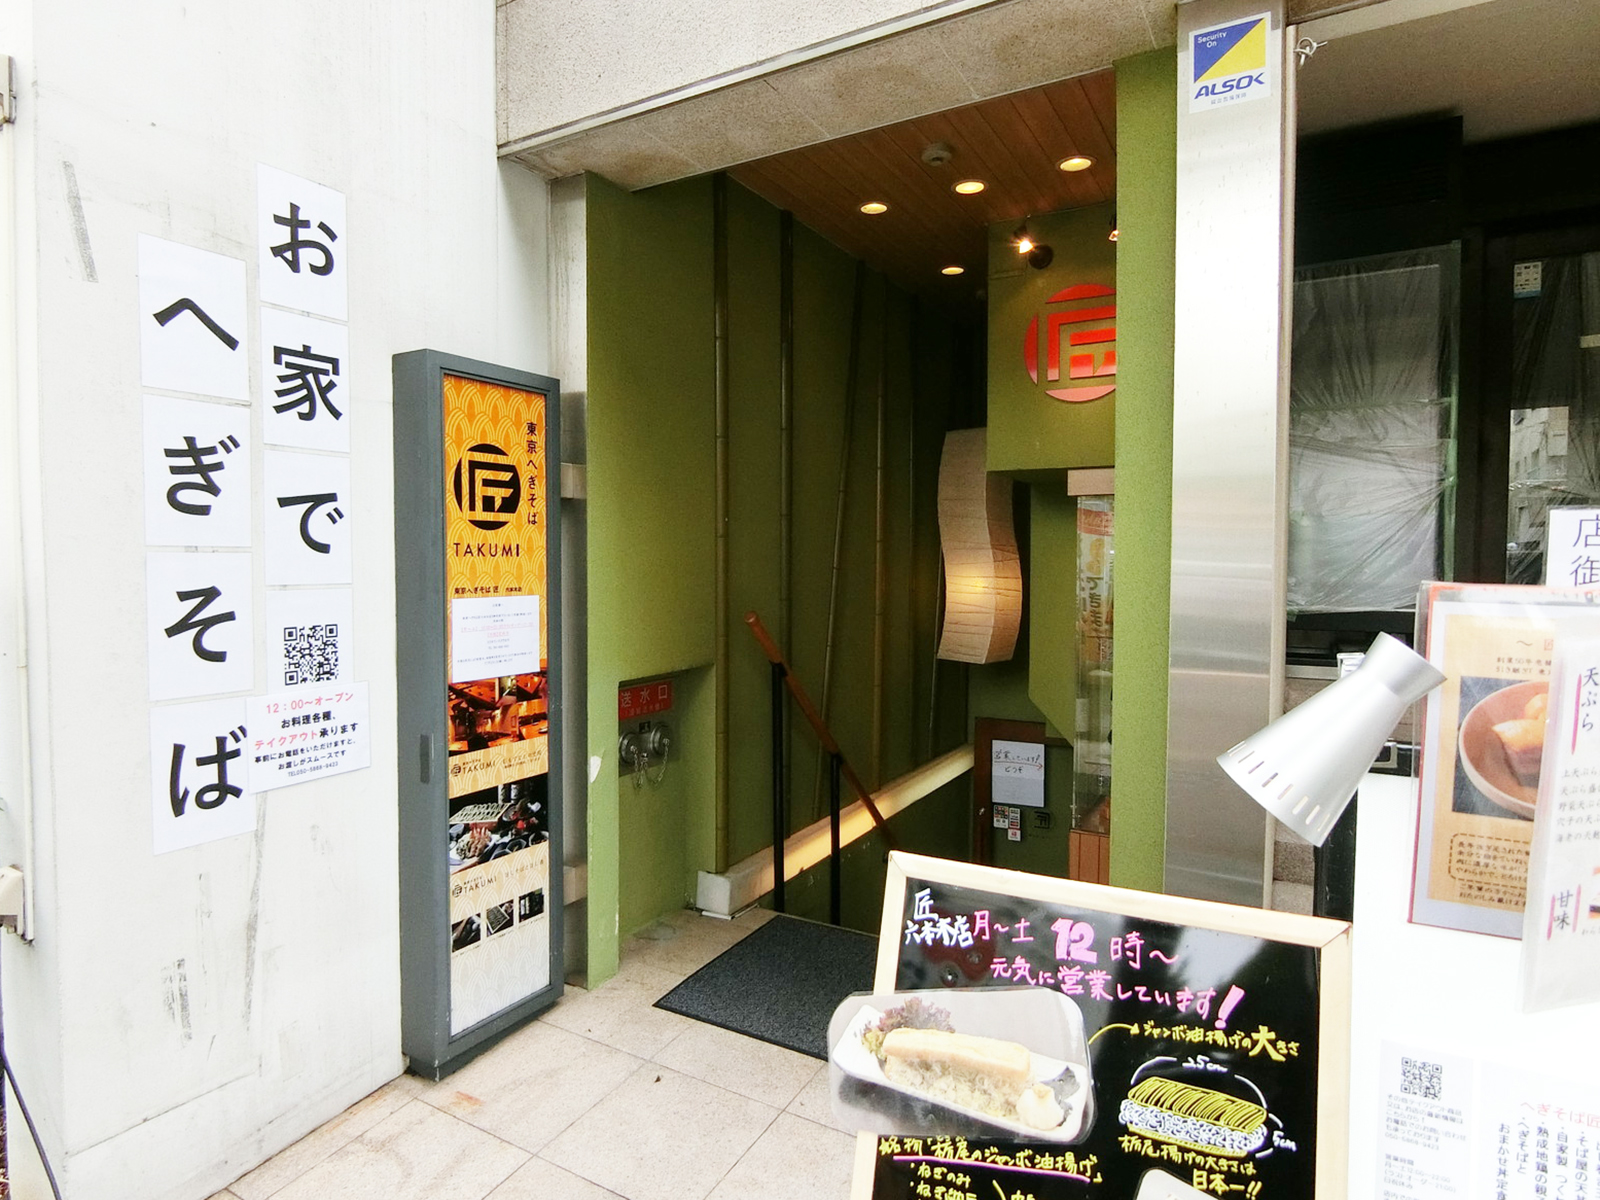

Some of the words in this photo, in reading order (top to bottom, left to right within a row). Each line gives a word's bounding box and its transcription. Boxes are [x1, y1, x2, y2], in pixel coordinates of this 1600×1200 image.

[1198, 31, 1227, 43] Security
[1194, 72, 1265, 100] ALSOK
[269, 202, 344, 554] お家で
[526, 421, 538, 525] 東京へぎそば
[153, 297, 247, 818] へぎそば
[453, 542, 520, 557] TAKUMI
[621, 684, 668, 708] 送水口
[1581, 667, 1599, 732] 天ぷら
[913, 887, 939, 922] 匠
[1553, 889, 1574, 930] 甘味
[905, 915, 974, 948] 六本木店
[1272, 1130, 1298, 1152] 5cm
